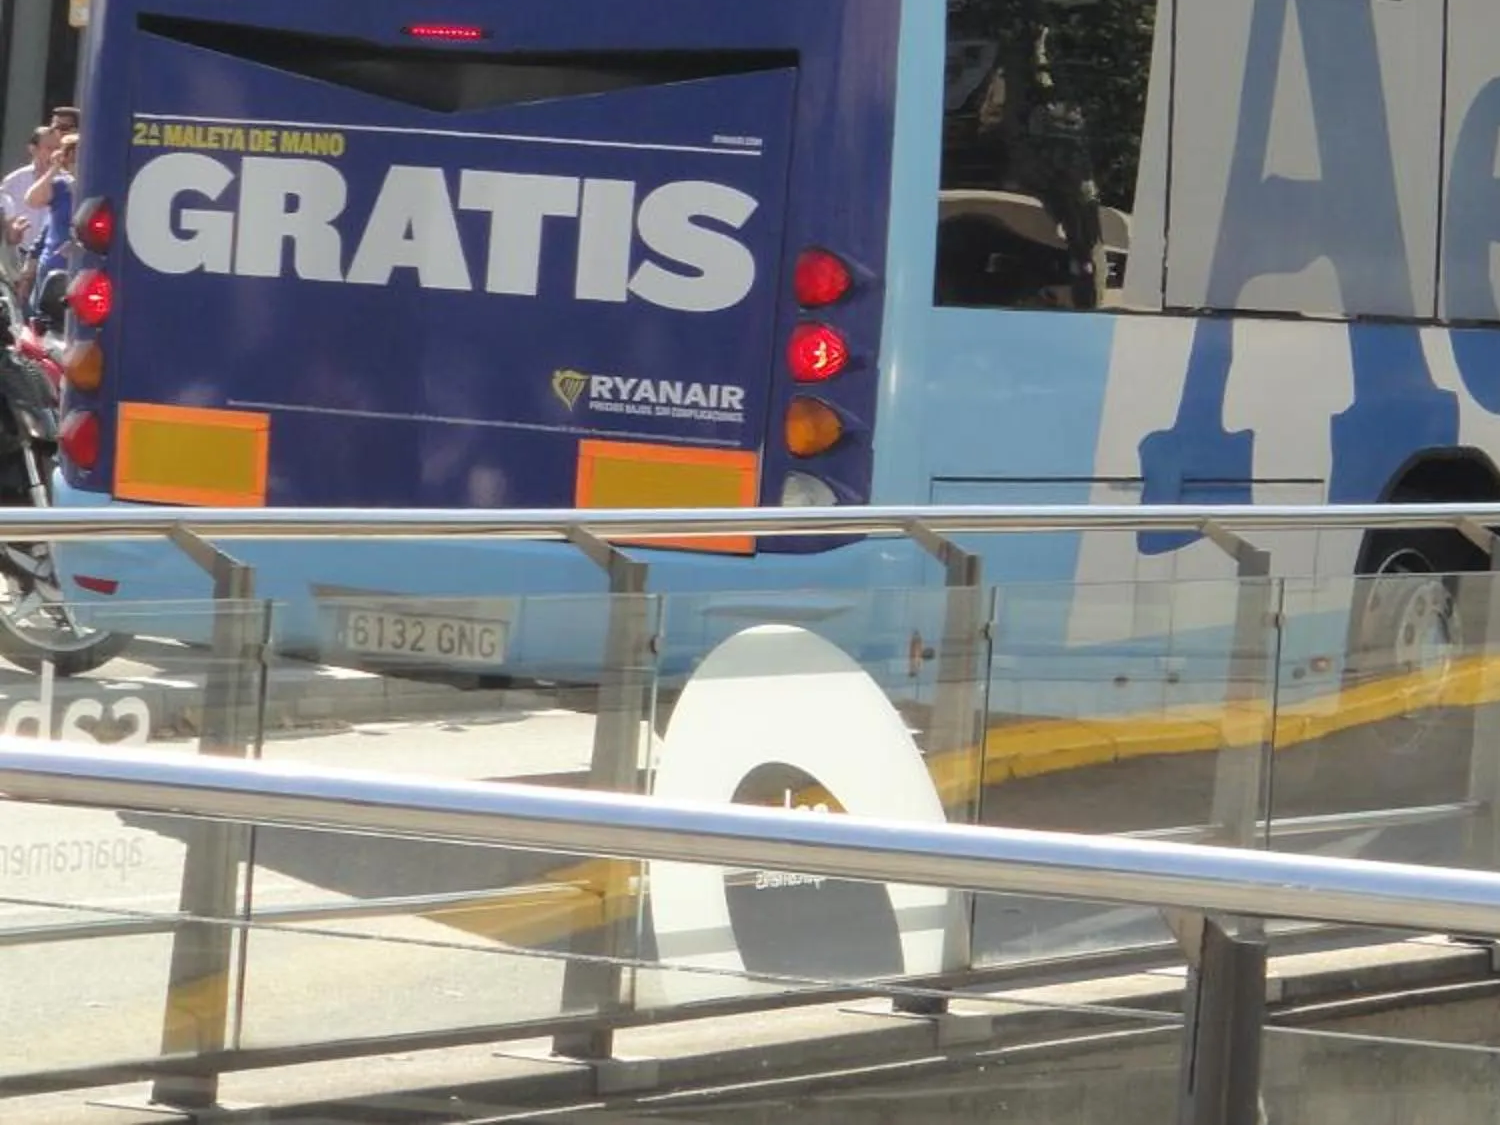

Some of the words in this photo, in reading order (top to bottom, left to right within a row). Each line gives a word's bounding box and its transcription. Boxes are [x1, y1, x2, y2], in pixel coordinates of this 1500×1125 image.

[163, 124, 245, 151] MALETA
[248, 129, 277, 152] DE
[280, 131, 345, 157] MANO
[126, 152, 759, 313] GRATIS
[590, 375, 745, 410] RYANAIR
[352, 614, 426, 653] 6132
[437, 622, 497, 659] GNG
